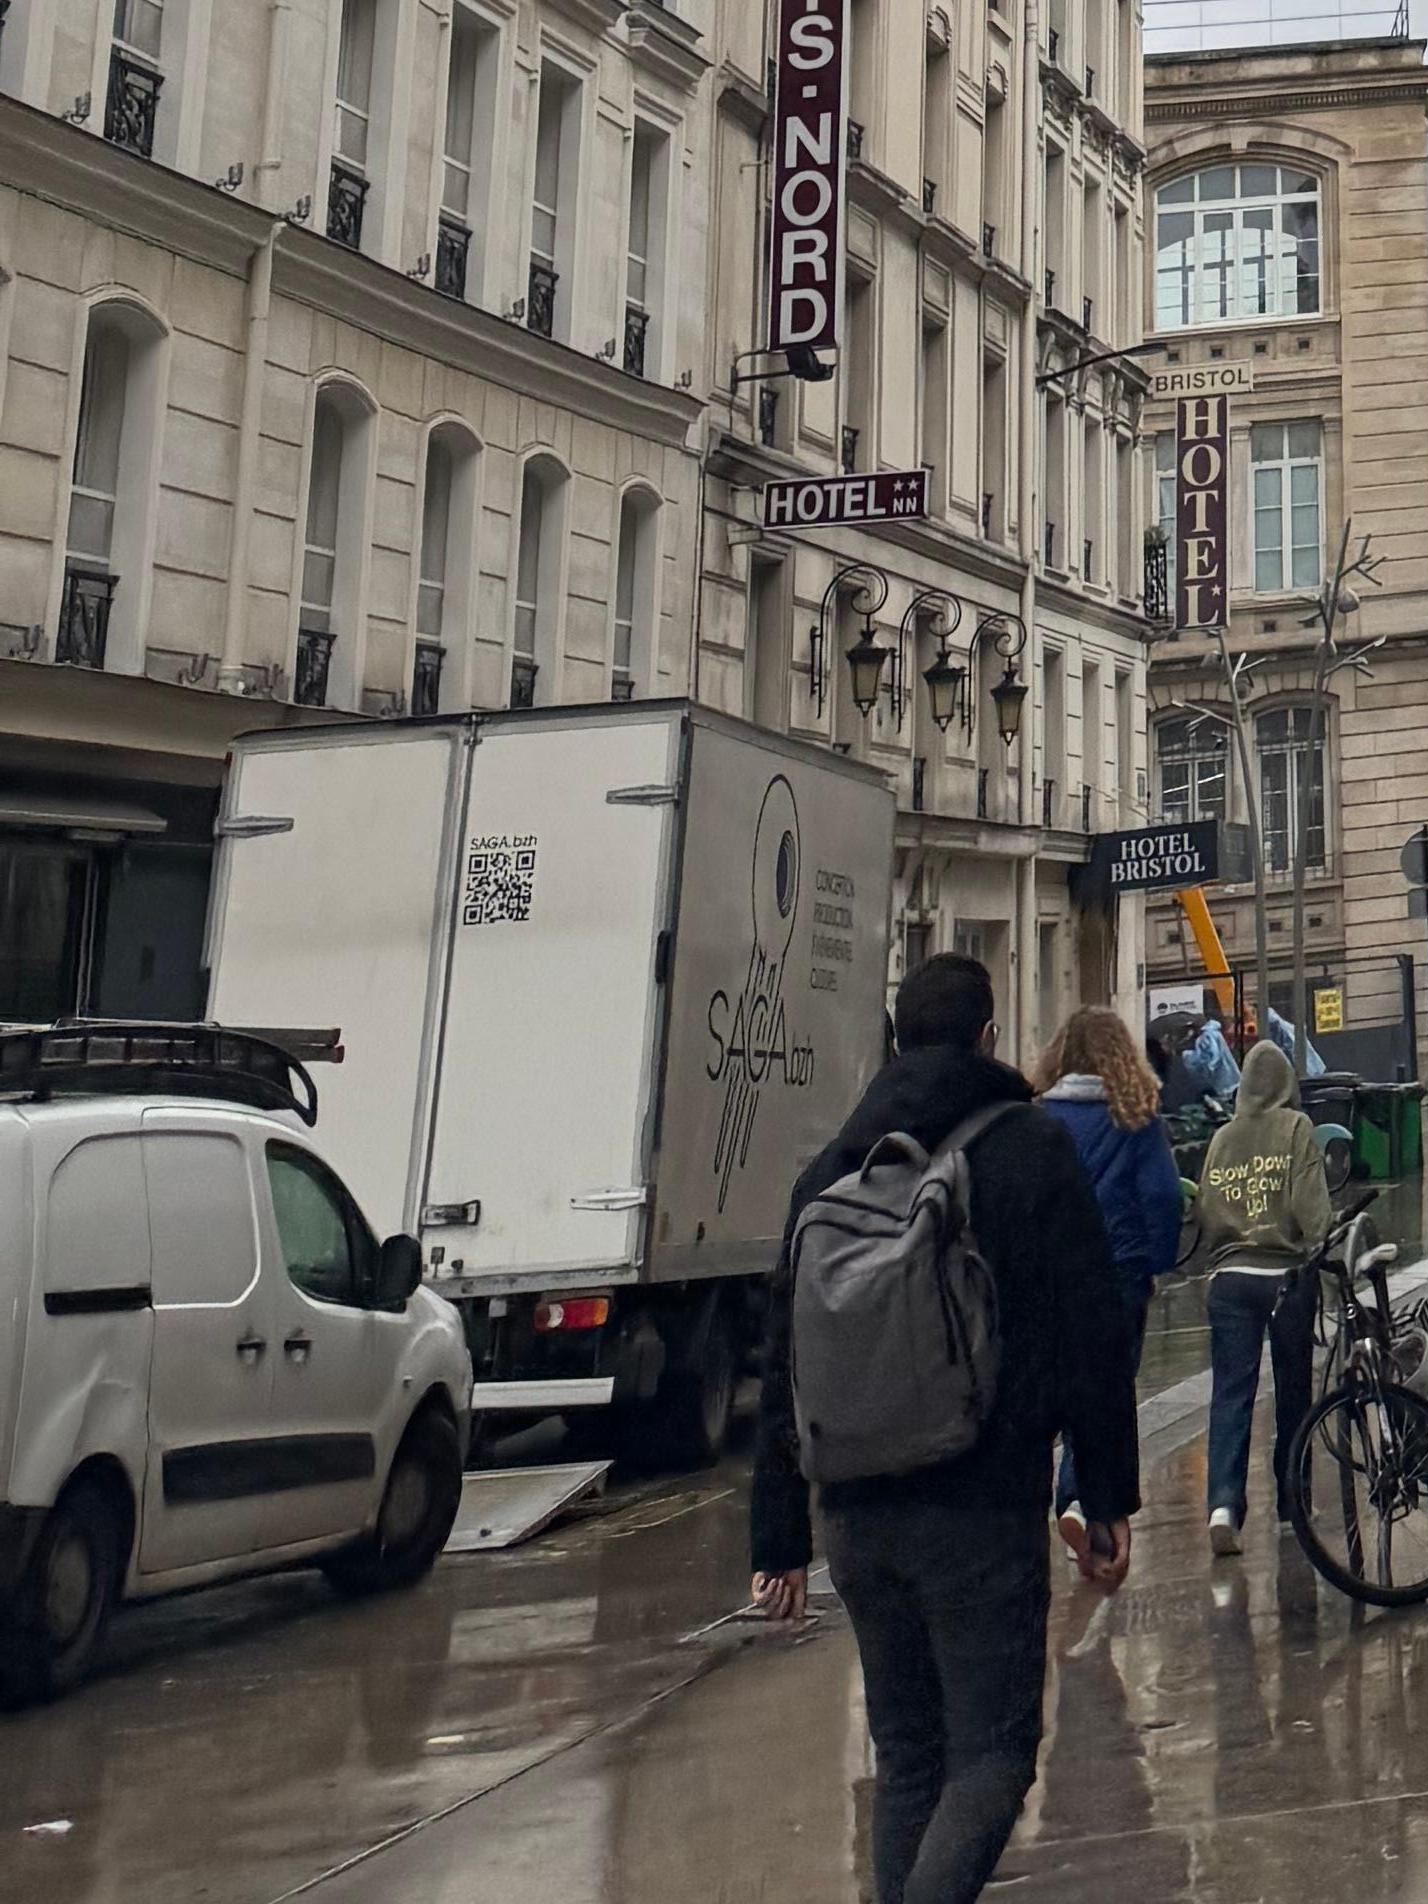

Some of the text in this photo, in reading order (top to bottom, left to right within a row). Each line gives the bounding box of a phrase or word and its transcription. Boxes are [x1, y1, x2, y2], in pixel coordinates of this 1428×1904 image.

[1155, 369, 1249, 392] BRISTOL
[769, 480, 917, 523] HOTEL NN
[1181, 396, 1223, 627] HOTEL
[1121, 833, 1195, 861] HOTEL
[1111, 852, 1206, 883] BRISTOL
[1220, 1184, 1242, 1203] To
